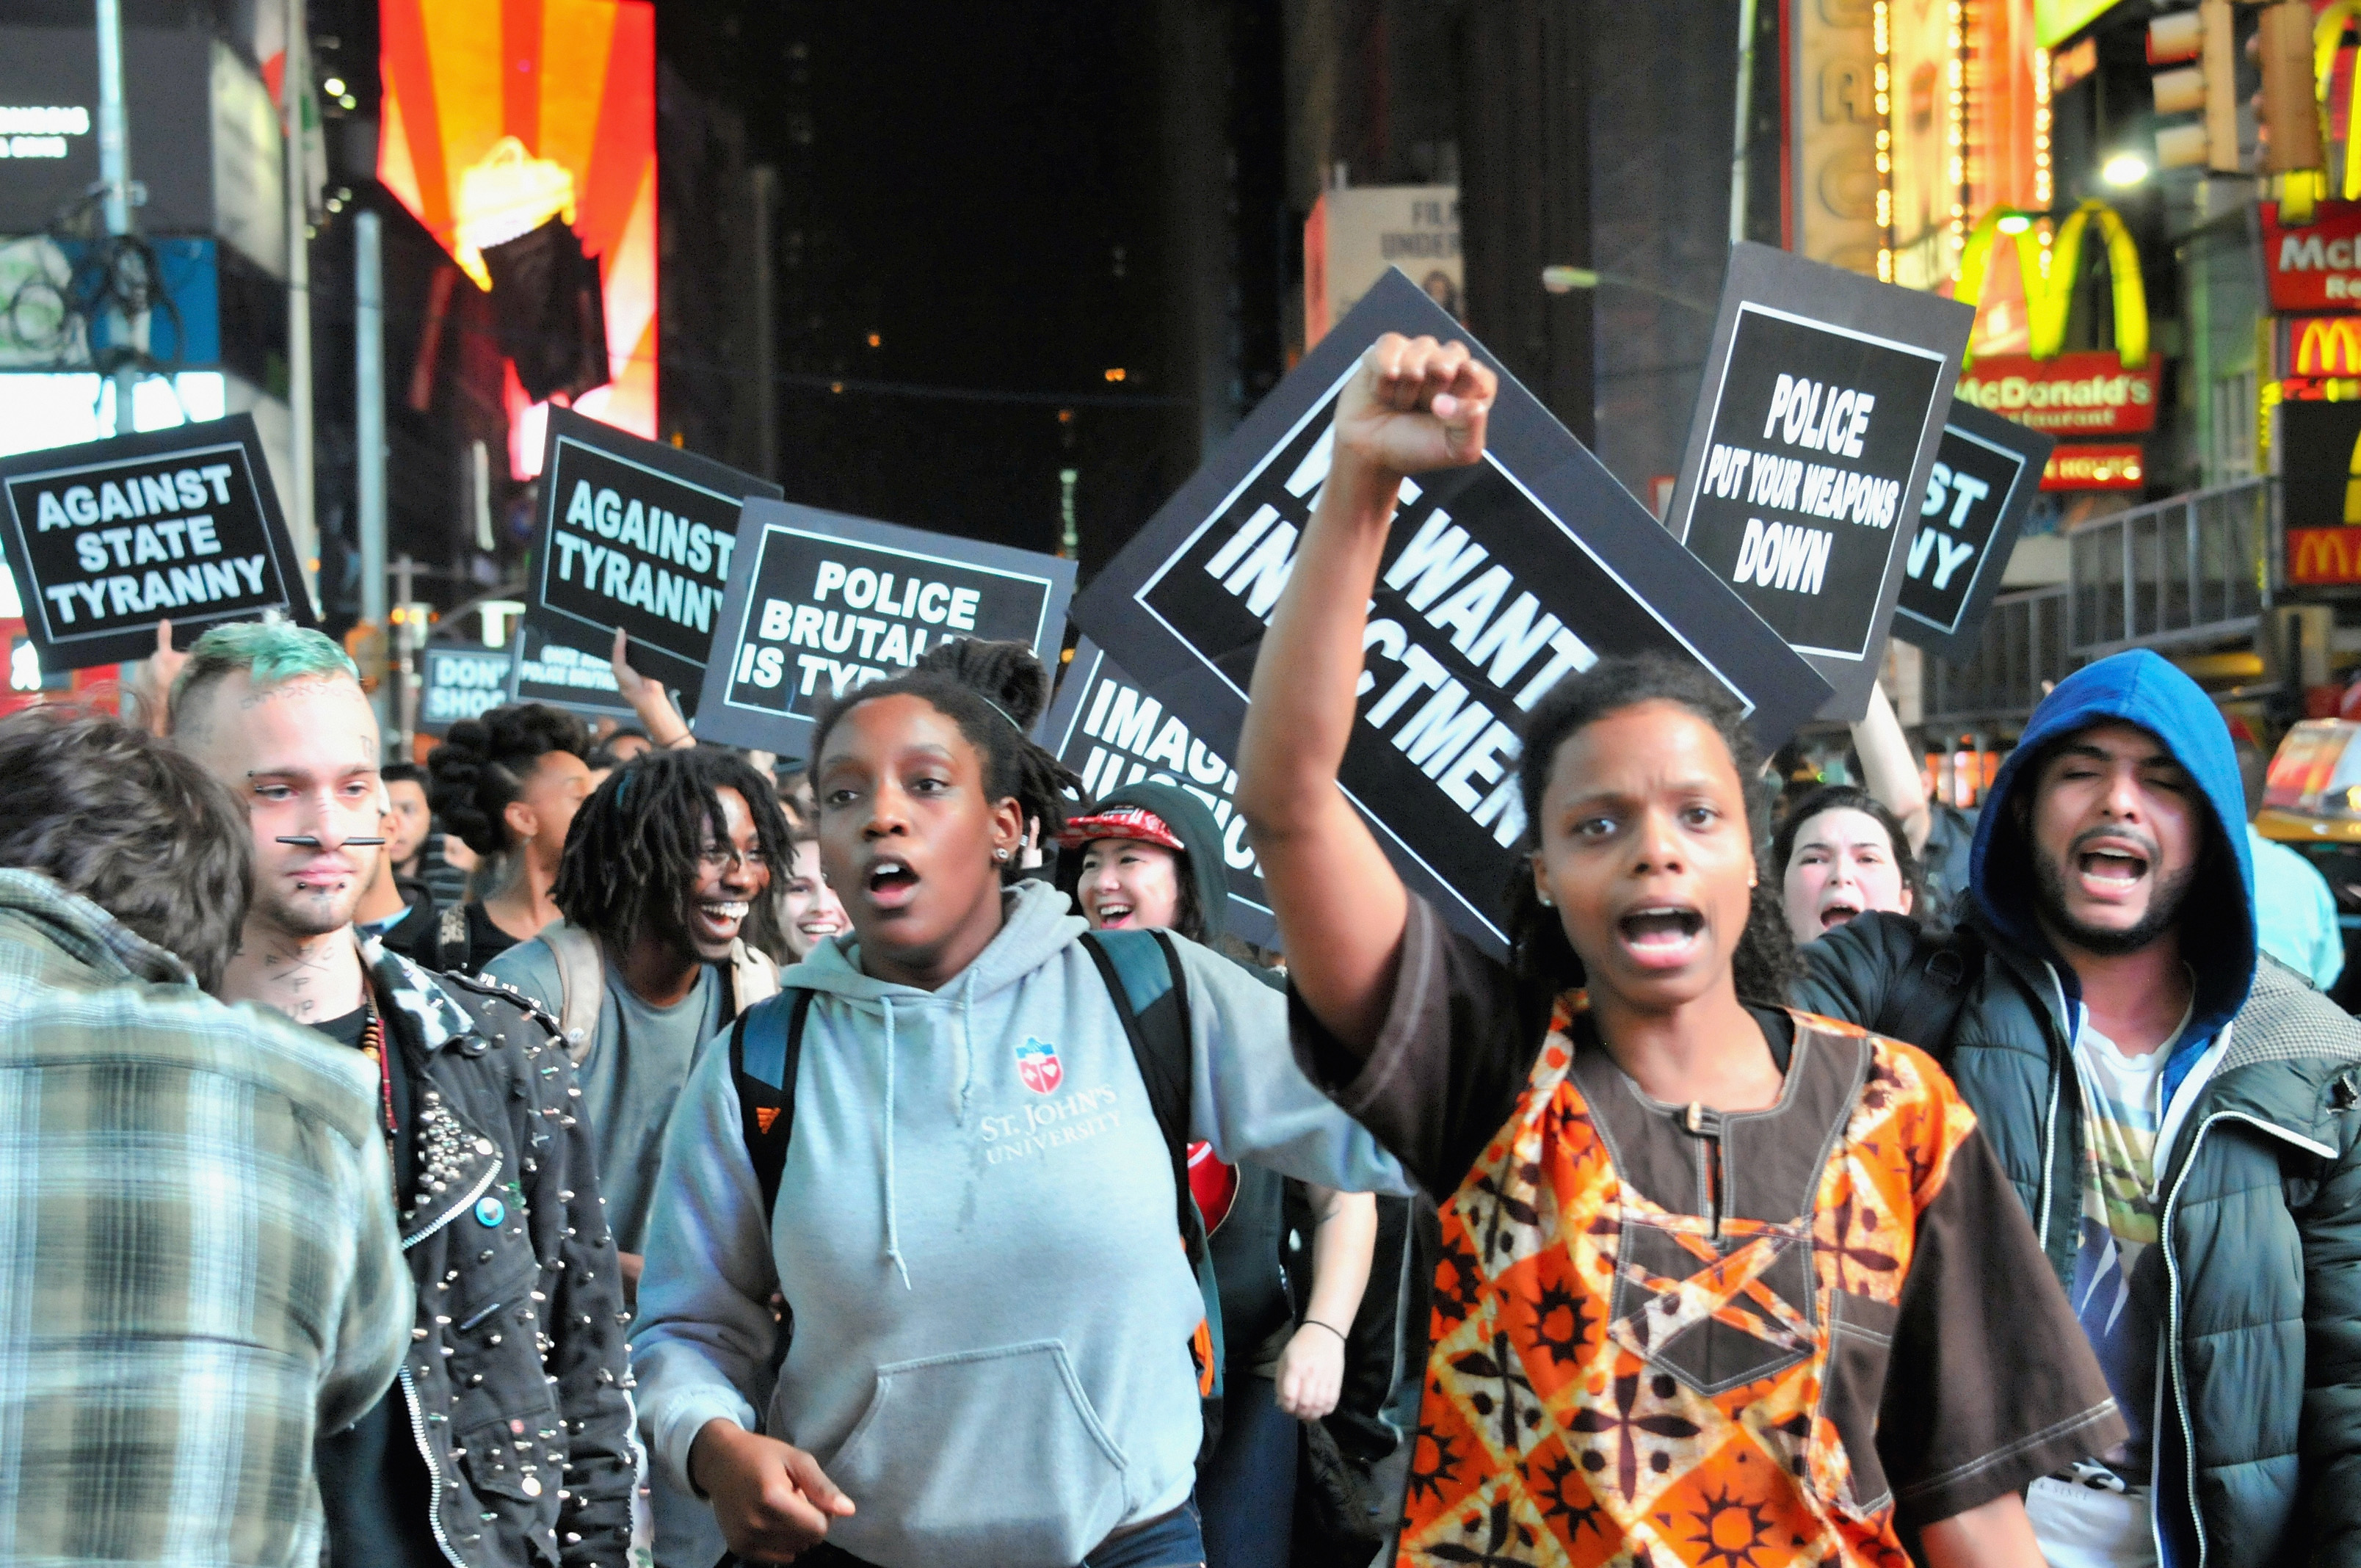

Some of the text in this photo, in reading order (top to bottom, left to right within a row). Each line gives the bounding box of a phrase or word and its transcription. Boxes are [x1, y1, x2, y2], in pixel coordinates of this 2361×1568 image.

[2278, 234, 2361, 272] Mc
[1763, 373, 1875, 458] POLICE
[37, 464, 232, 532] AGAINST
[1703, 444, 1899, 529] PUT YOUR WEAPONS
[76, 514, 222, 572] STATE
[566, 479, 736, 581] AGAINST
[1733, 518, 1833, 595] DOWN
[46, 554, 266, 624] TYRANNY
[813, 560, 981, 631] POLICE
[1383, 507, 1599, 712] WANT
[736, 643, 784, 688] IS
[981, 1084, 1117, 1141] ST. JOHN'S
[984, 1109, 1121, 1164] UNIVERSITY
